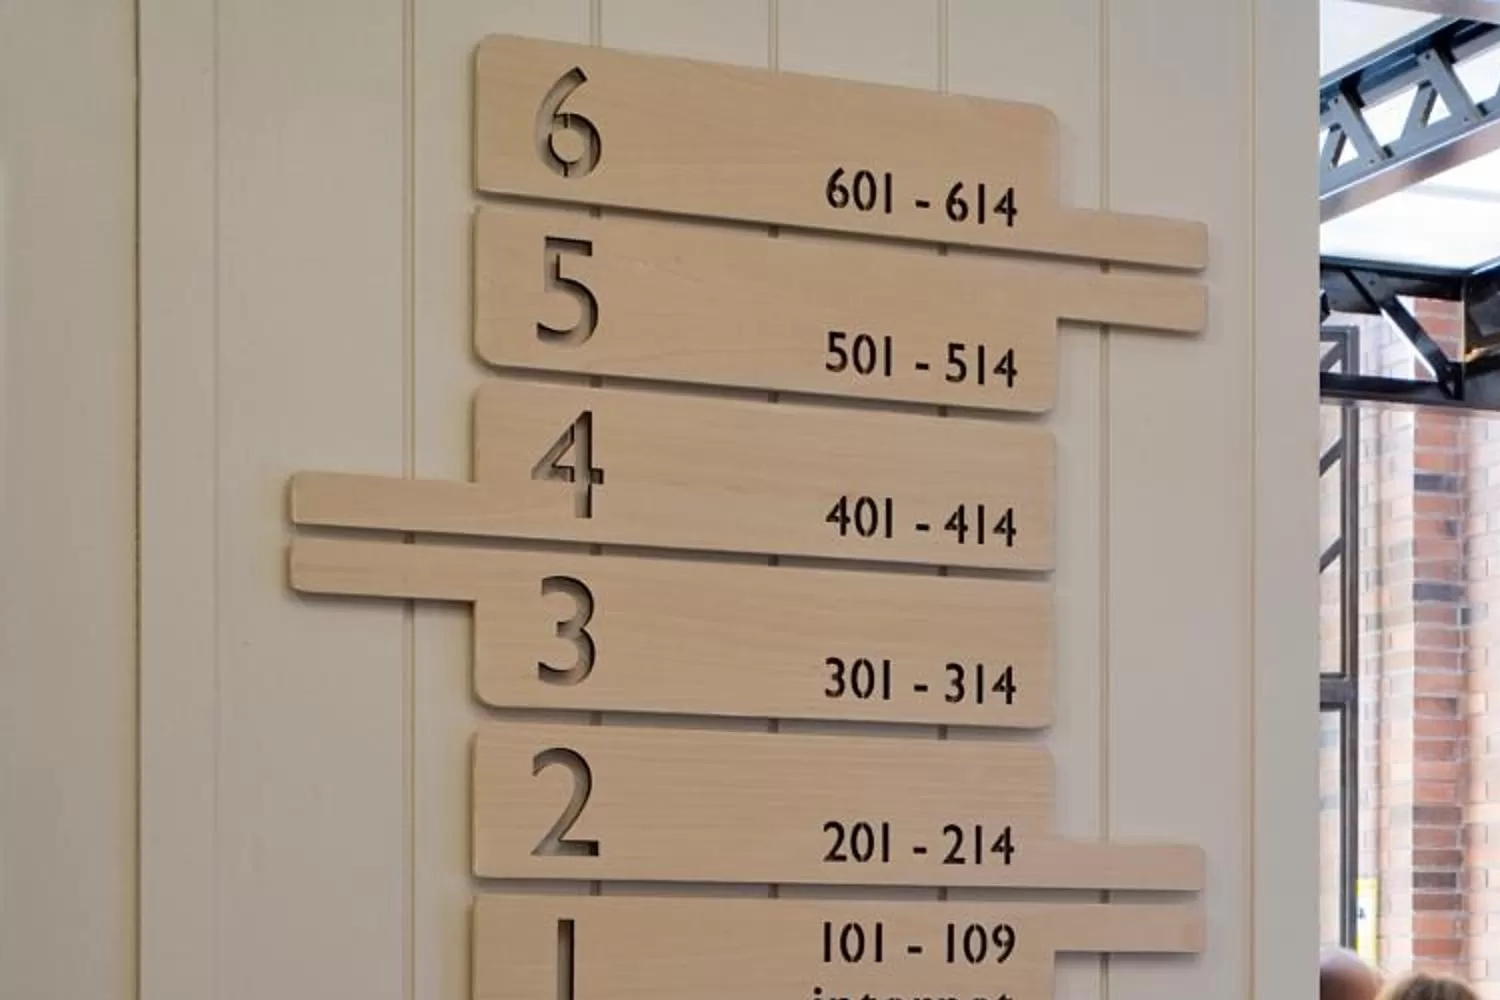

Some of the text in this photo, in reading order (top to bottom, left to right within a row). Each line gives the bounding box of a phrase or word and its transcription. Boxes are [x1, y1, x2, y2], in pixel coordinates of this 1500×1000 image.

[535, 65, 602, 178] 6
[825, 167, 1018, 227] 601 - 614
[535, 235, 600, 345] 5
[825, 330, 1018, 388] 501 - 514
[530, 409, 605, 519] 4
[825, 495, 1017, 548] 401 - 414
[536, 575, 597, 687] 3
[824, 656, 1017, 705] 301 - 314
[530, 746, 600, 858] 2
[822, 820, 1016, 865] 201 - 214
[822, 921, 1017, 964] 101 - 109
